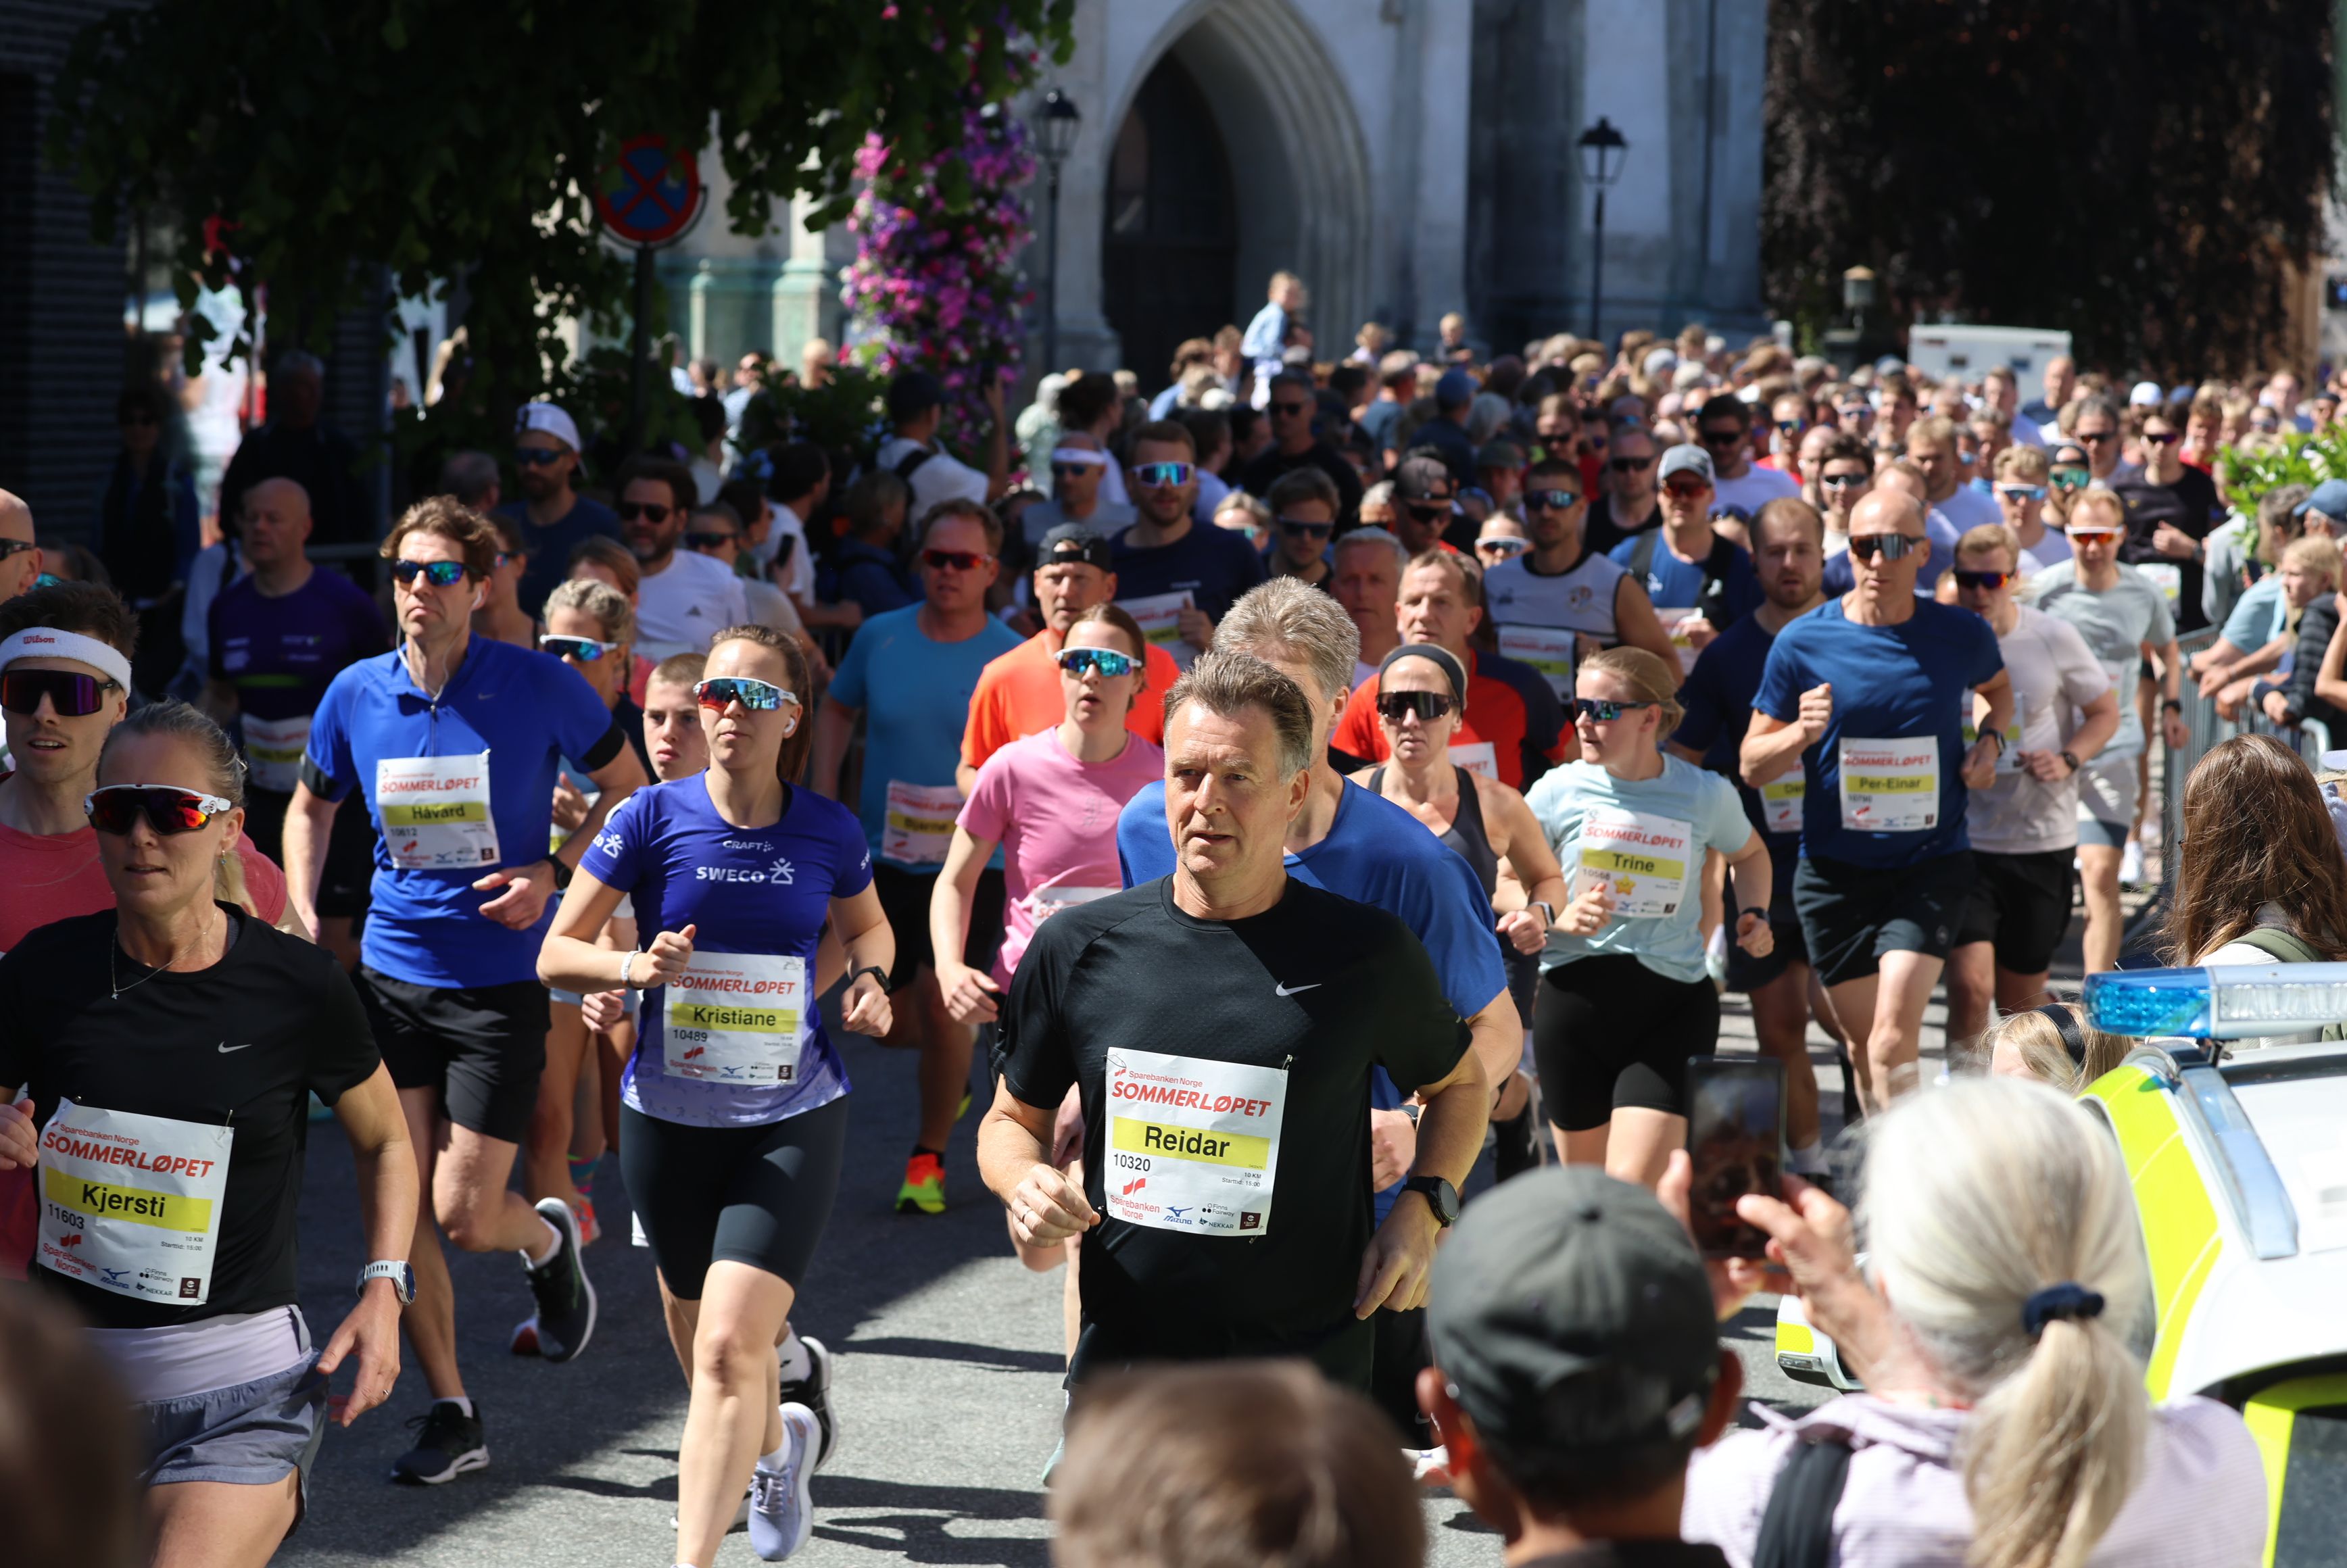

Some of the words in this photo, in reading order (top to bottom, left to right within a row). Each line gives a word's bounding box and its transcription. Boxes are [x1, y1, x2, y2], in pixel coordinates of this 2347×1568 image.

[22, 635, 55, 645] Wilson
[1844, 755, 1931, 768] SOMMERLØPET
[381, 777, 479, 793] SOMMERLØPET
[1860, 778, 1921, 789] Per-Einar
[412, 805, 465, 819] Håvard
[723, 840, 763, 850] CRAFT
[1585, 827, 1684, 849] SOMMERLØPET
[1613, 853, 1655, 872] Trine
[696, 866, 765, 883] SWECO
[671, 975, 795, 995] SOMMERLØPET
[694, 1007, 776, 1026] Kristiane
[673, 1029, 708, 1042] 10489
[1129, 1070, 1178, 1085] Sparebanken
[1180, 1077, 1203, 1087] Norge
[1111, 1081, 1271, 1117] SOMMERLØPET
[59, 1123, 113, 1141] Sparebanken
[114, 1134, 140, 1146] Norge
[1144, 1125, 1230, 1158] Reidar
[43, 1131, 214, 1178] SOMMERLØPET
[1113, 1153, 1151, 1172] 10320
[1221, 1177, 1244, 1185] Starttid:
[82, 1183, 166, 1217] Kjersti
[1110, 1194, 1160, 1213] Sparebanken
[48, 1204, 84, 1229] 11603
[1122, 1207, 1144, 1220] Norge
[1212, 1209, 1235, 1217] Fairway
[43, 1242, 97, 1272] Sparebanken
[54, 1258, 82, 1276] Norge
[145, 1288, 173, 1296] NEKKAR
